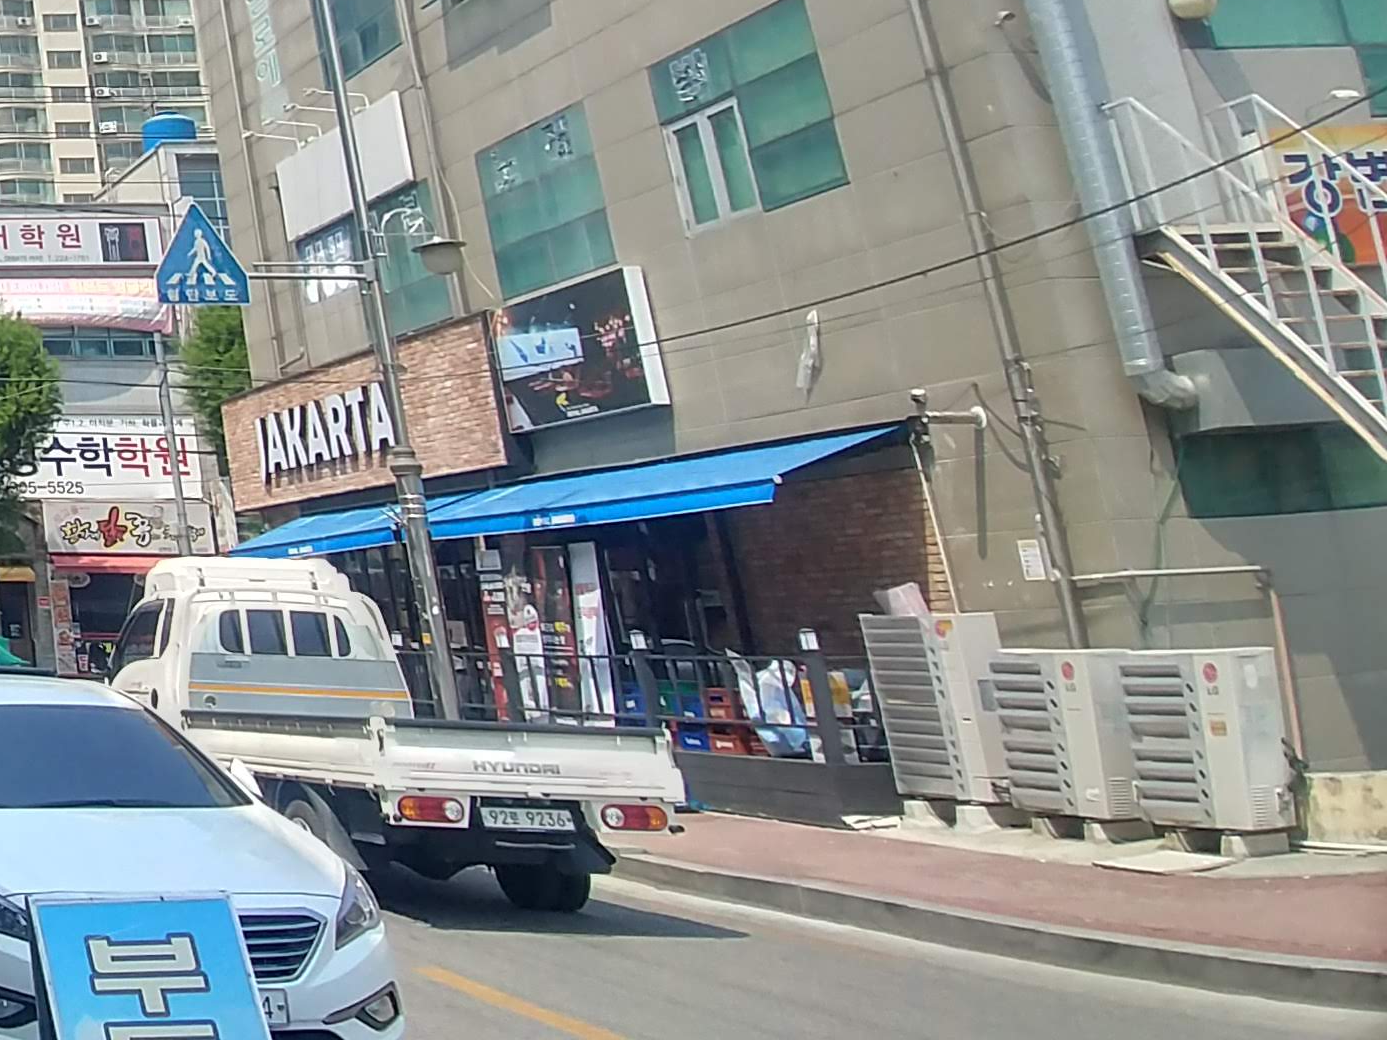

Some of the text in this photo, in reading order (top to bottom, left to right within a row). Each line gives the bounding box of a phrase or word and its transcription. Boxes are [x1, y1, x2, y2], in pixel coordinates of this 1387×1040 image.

[258, 382, 396, 483] JAKARTA
[473, 760, 560, 775] HYUNDAI
[527, 814, 565, 828] 9236
